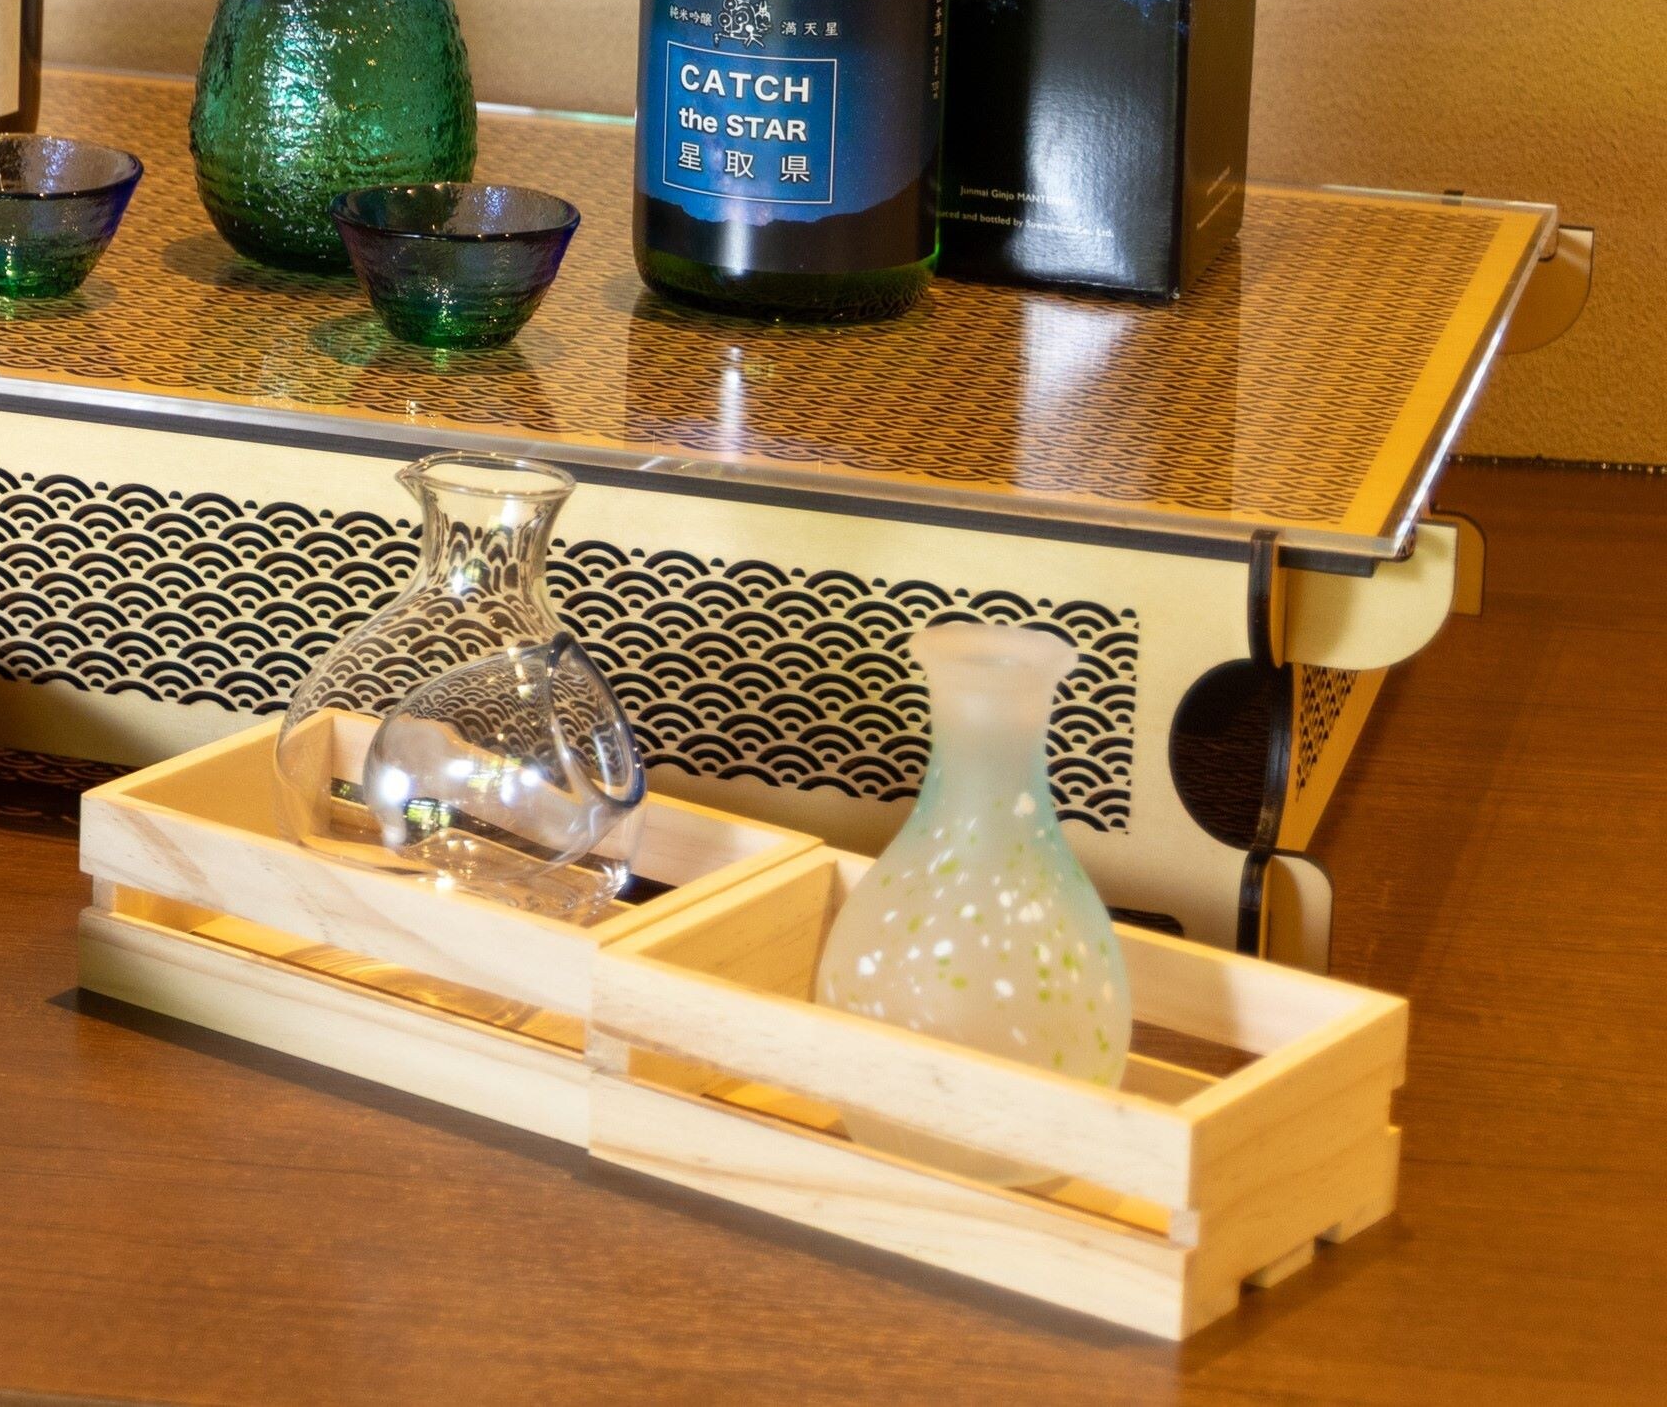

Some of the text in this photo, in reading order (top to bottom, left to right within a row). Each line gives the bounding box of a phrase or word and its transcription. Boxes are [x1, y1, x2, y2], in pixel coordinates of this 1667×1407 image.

[669, 4, 713, 27] 純米吟醸
[781, 21, 839, 37] 満天星
[679, 64, 811, 103] CATCH
[679, 107, 807, 142] the STAR
[678, 142, 810, 183] 星取県
[960, 186, 989, 198] Junmai
[991, 189, 1015, 201] Ginjo
[962, 211, 978, 222] and
[979, 214, 1011, 226] bottled
[1013, 218, 1023, 228] by
